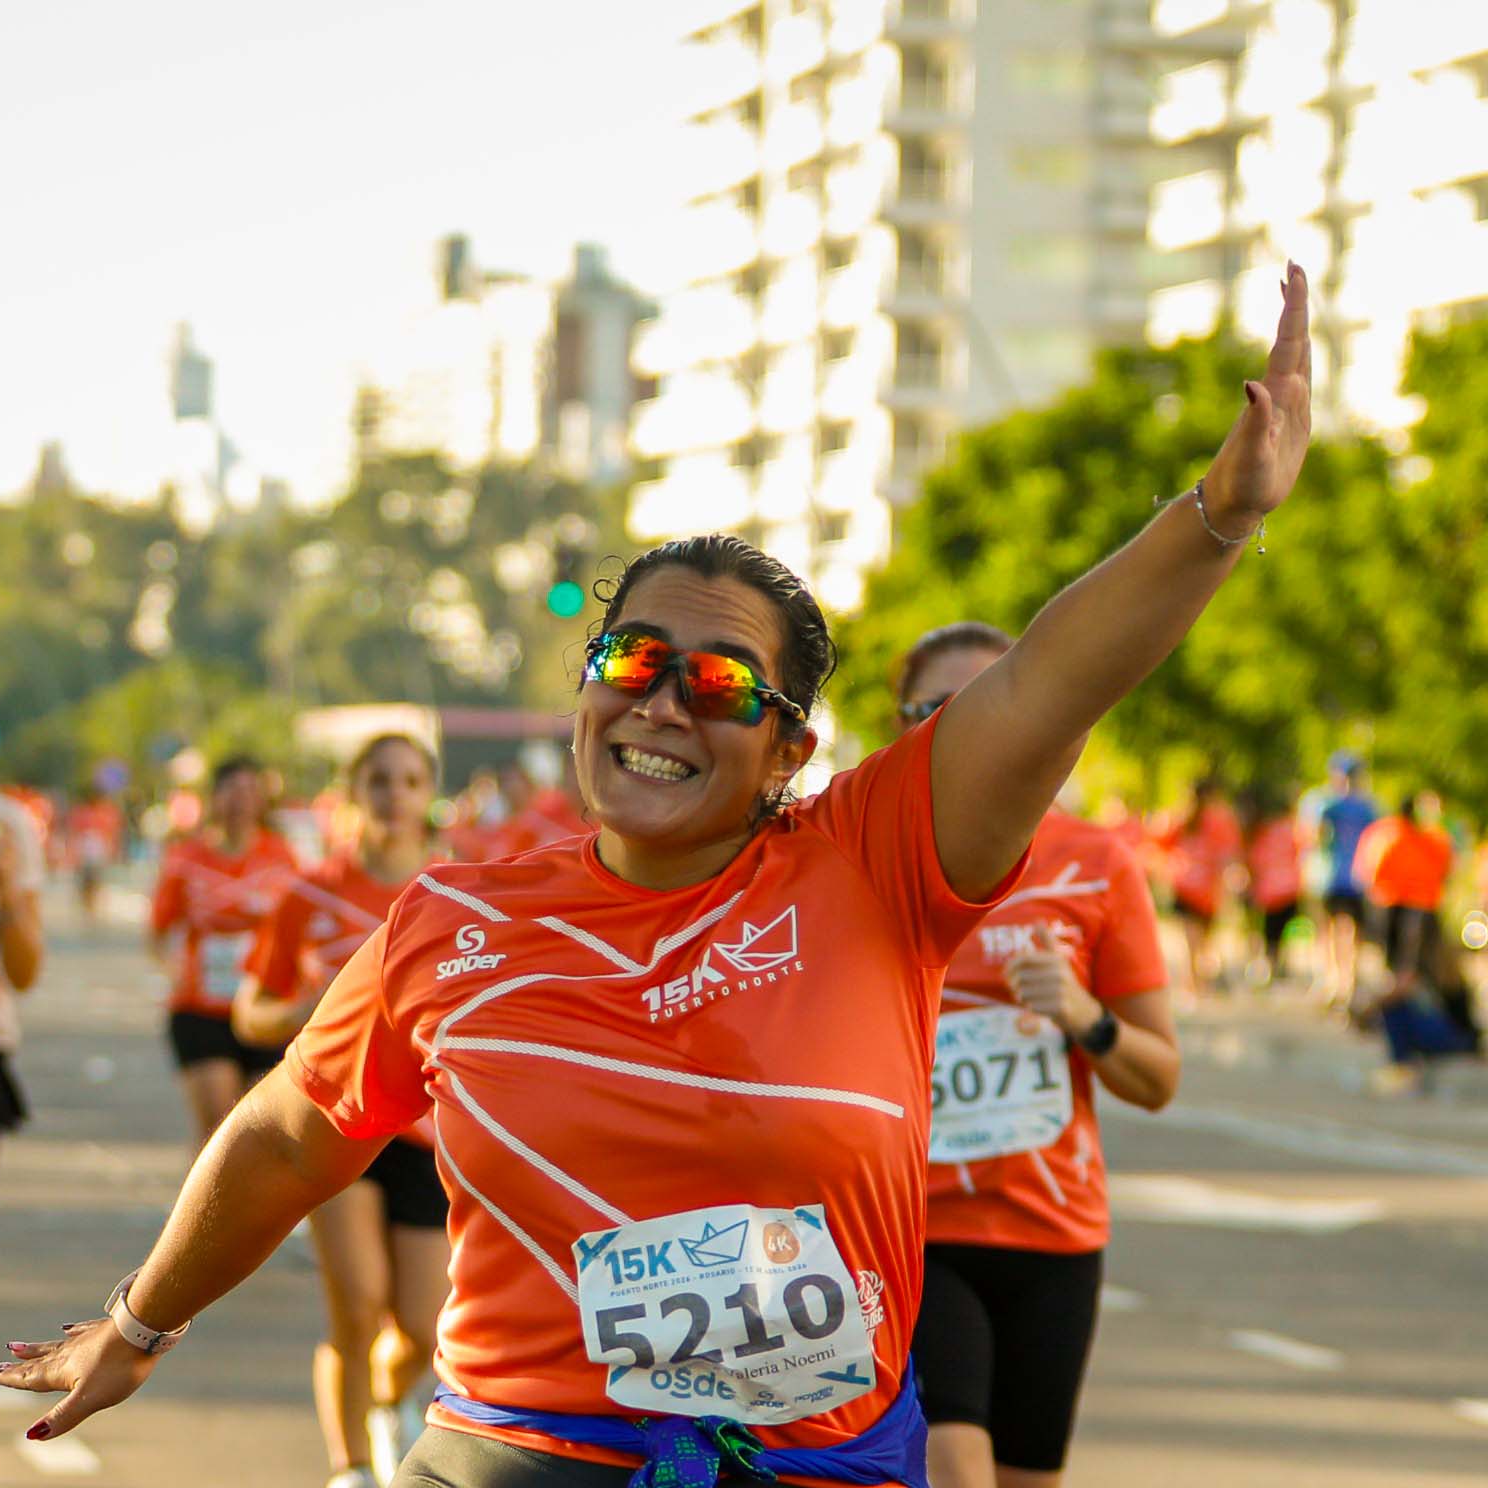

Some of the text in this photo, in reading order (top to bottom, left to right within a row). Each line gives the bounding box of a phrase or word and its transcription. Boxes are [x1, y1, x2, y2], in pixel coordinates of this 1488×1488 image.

[641, 947, 726, 1012] 15K
[650, 960, 804, 1023] PUERTO NORTE
[604, 1235, 793, 1285] 15K 4K
[595, 1274, 845, 1369] 5210
[651, 1363, 737, 1400] osde
[783, 1344, 837, 1370] Noemi
